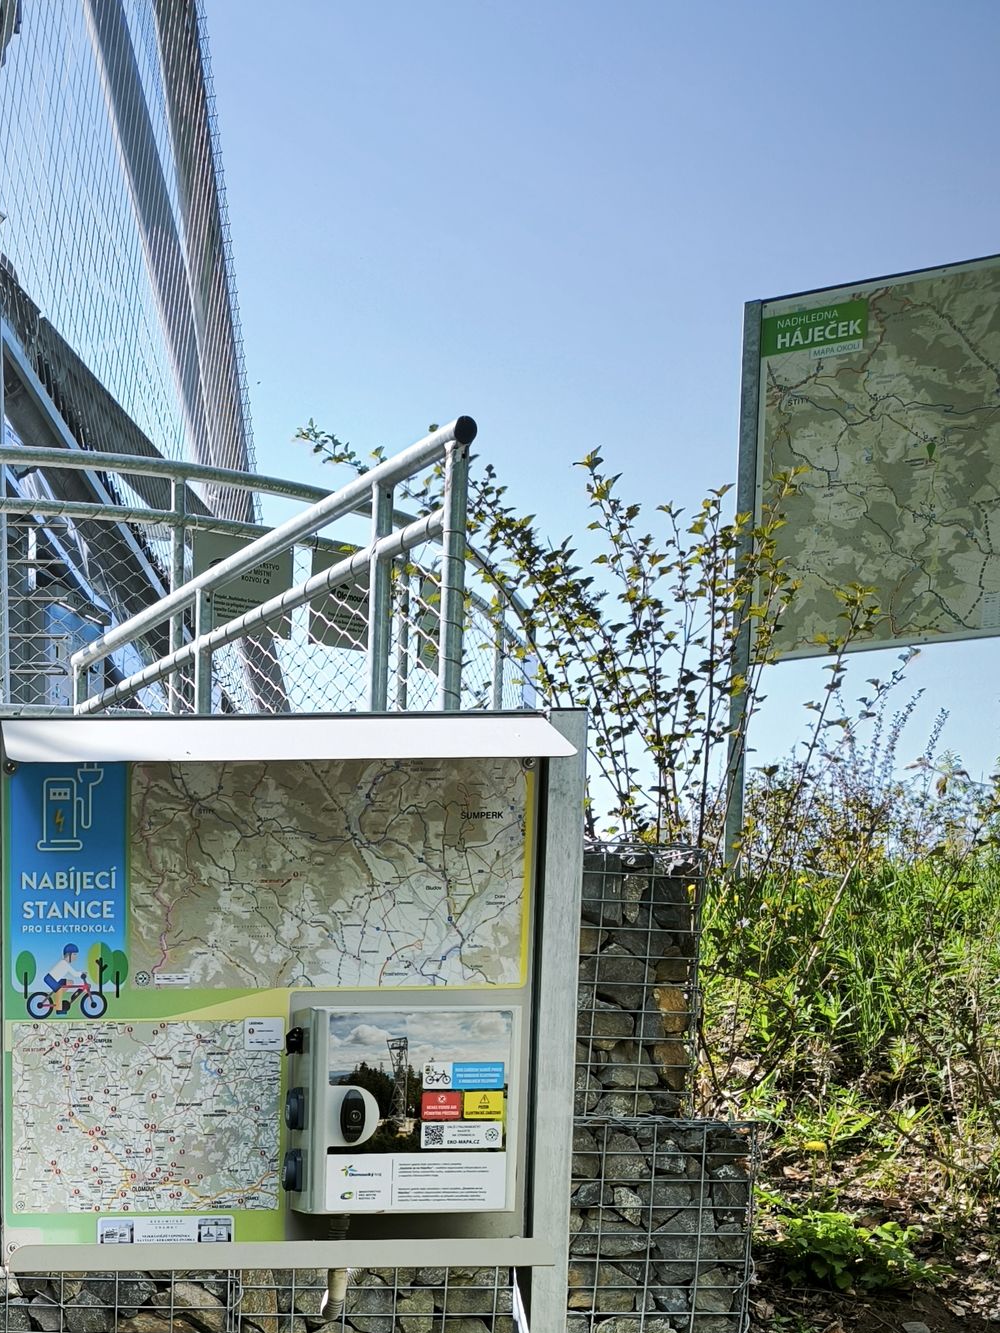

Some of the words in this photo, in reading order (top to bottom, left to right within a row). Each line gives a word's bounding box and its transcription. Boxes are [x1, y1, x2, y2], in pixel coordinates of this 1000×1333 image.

[777, 319, 863, 349] HÁJEČEK
[812, 345, 835, 357] MAPA
[836, 342, 860, 353] OKOLÍ
[460, 810, 504, 820] ŠUMPERK
[21, 866, 117, 896] NABÍJECÍ
[22, 900, 115, 919] STANICE
[22, 925, 42, 933] PRO
[45, 924, 116, 933] ELEKTROKOLA
